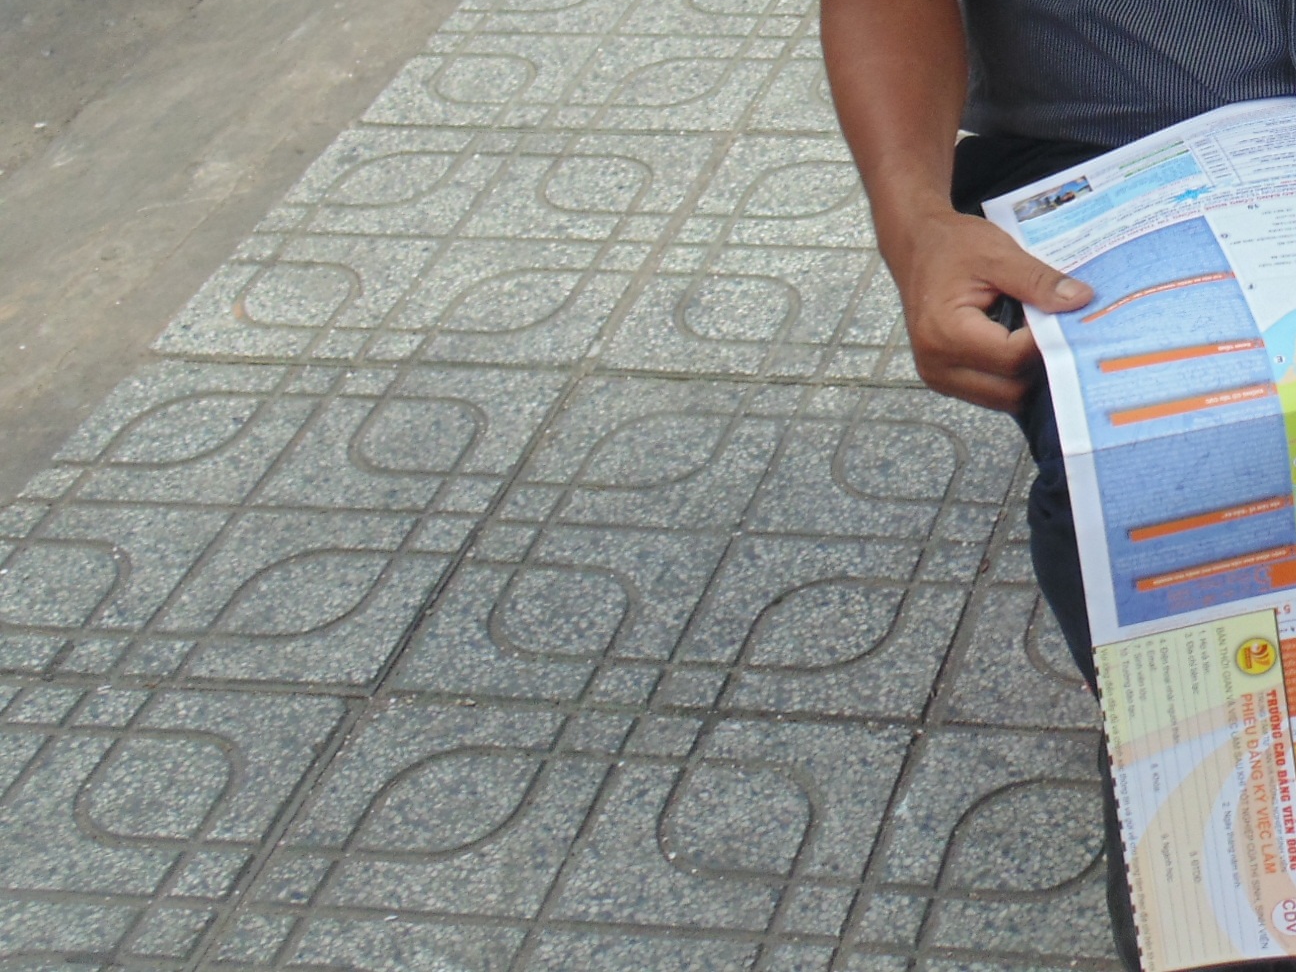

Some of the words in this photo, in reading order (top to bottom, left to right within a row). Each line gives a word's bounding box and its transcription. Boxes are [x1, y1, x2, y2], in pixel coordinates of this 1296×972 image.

[1241, 693, 1258, 735] PHIẾU
[1266, 689, 1284, 739] TRƯỜNG
[1273, 741, 1285, 766] CAO
[1256, 805, 1273, 840] VIỆC
[1261, 843, 1279, 874] LÀM
